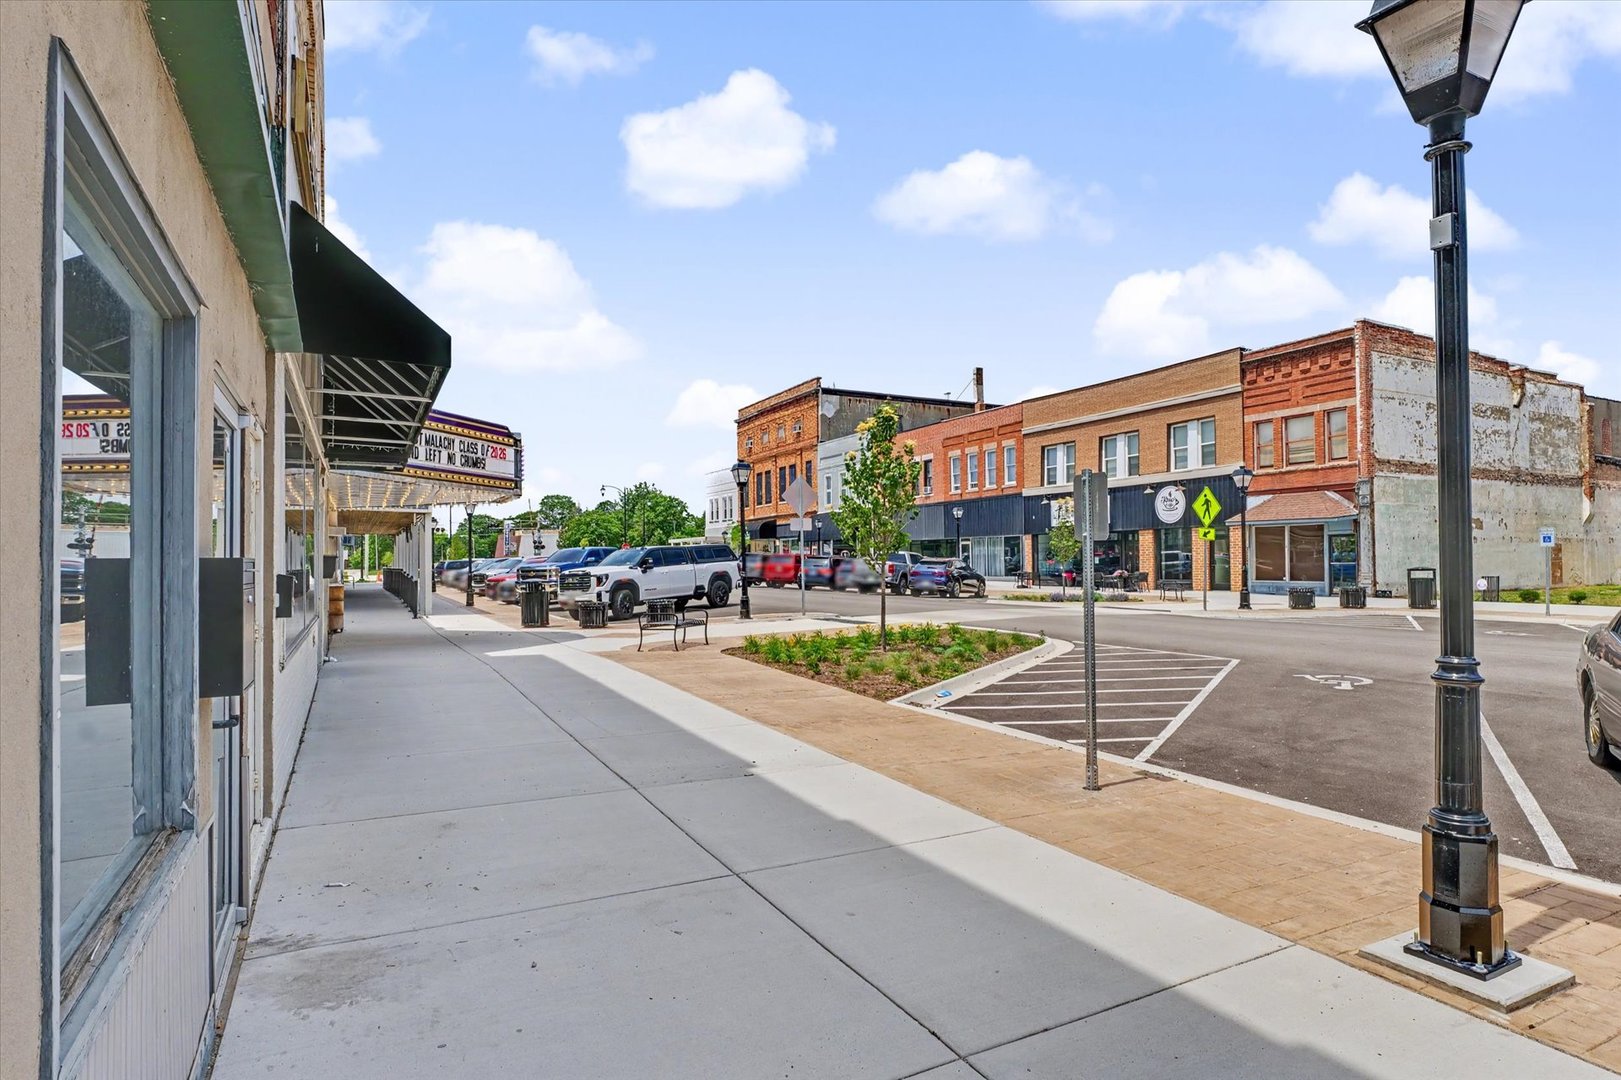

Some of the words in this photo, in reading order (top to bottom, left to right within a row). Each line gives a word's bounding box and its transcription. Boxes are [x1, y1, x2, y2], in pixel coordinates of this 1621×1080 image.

[425, 433, 456, 451] MALACHY
[459, 440, 478, 455] CLASS
[481, 444, 490, 457] OF
[490, 445, 507, 460] 2026
[425, 448, 442, 464] LEFT
[447, 452, 456, 466] NO
